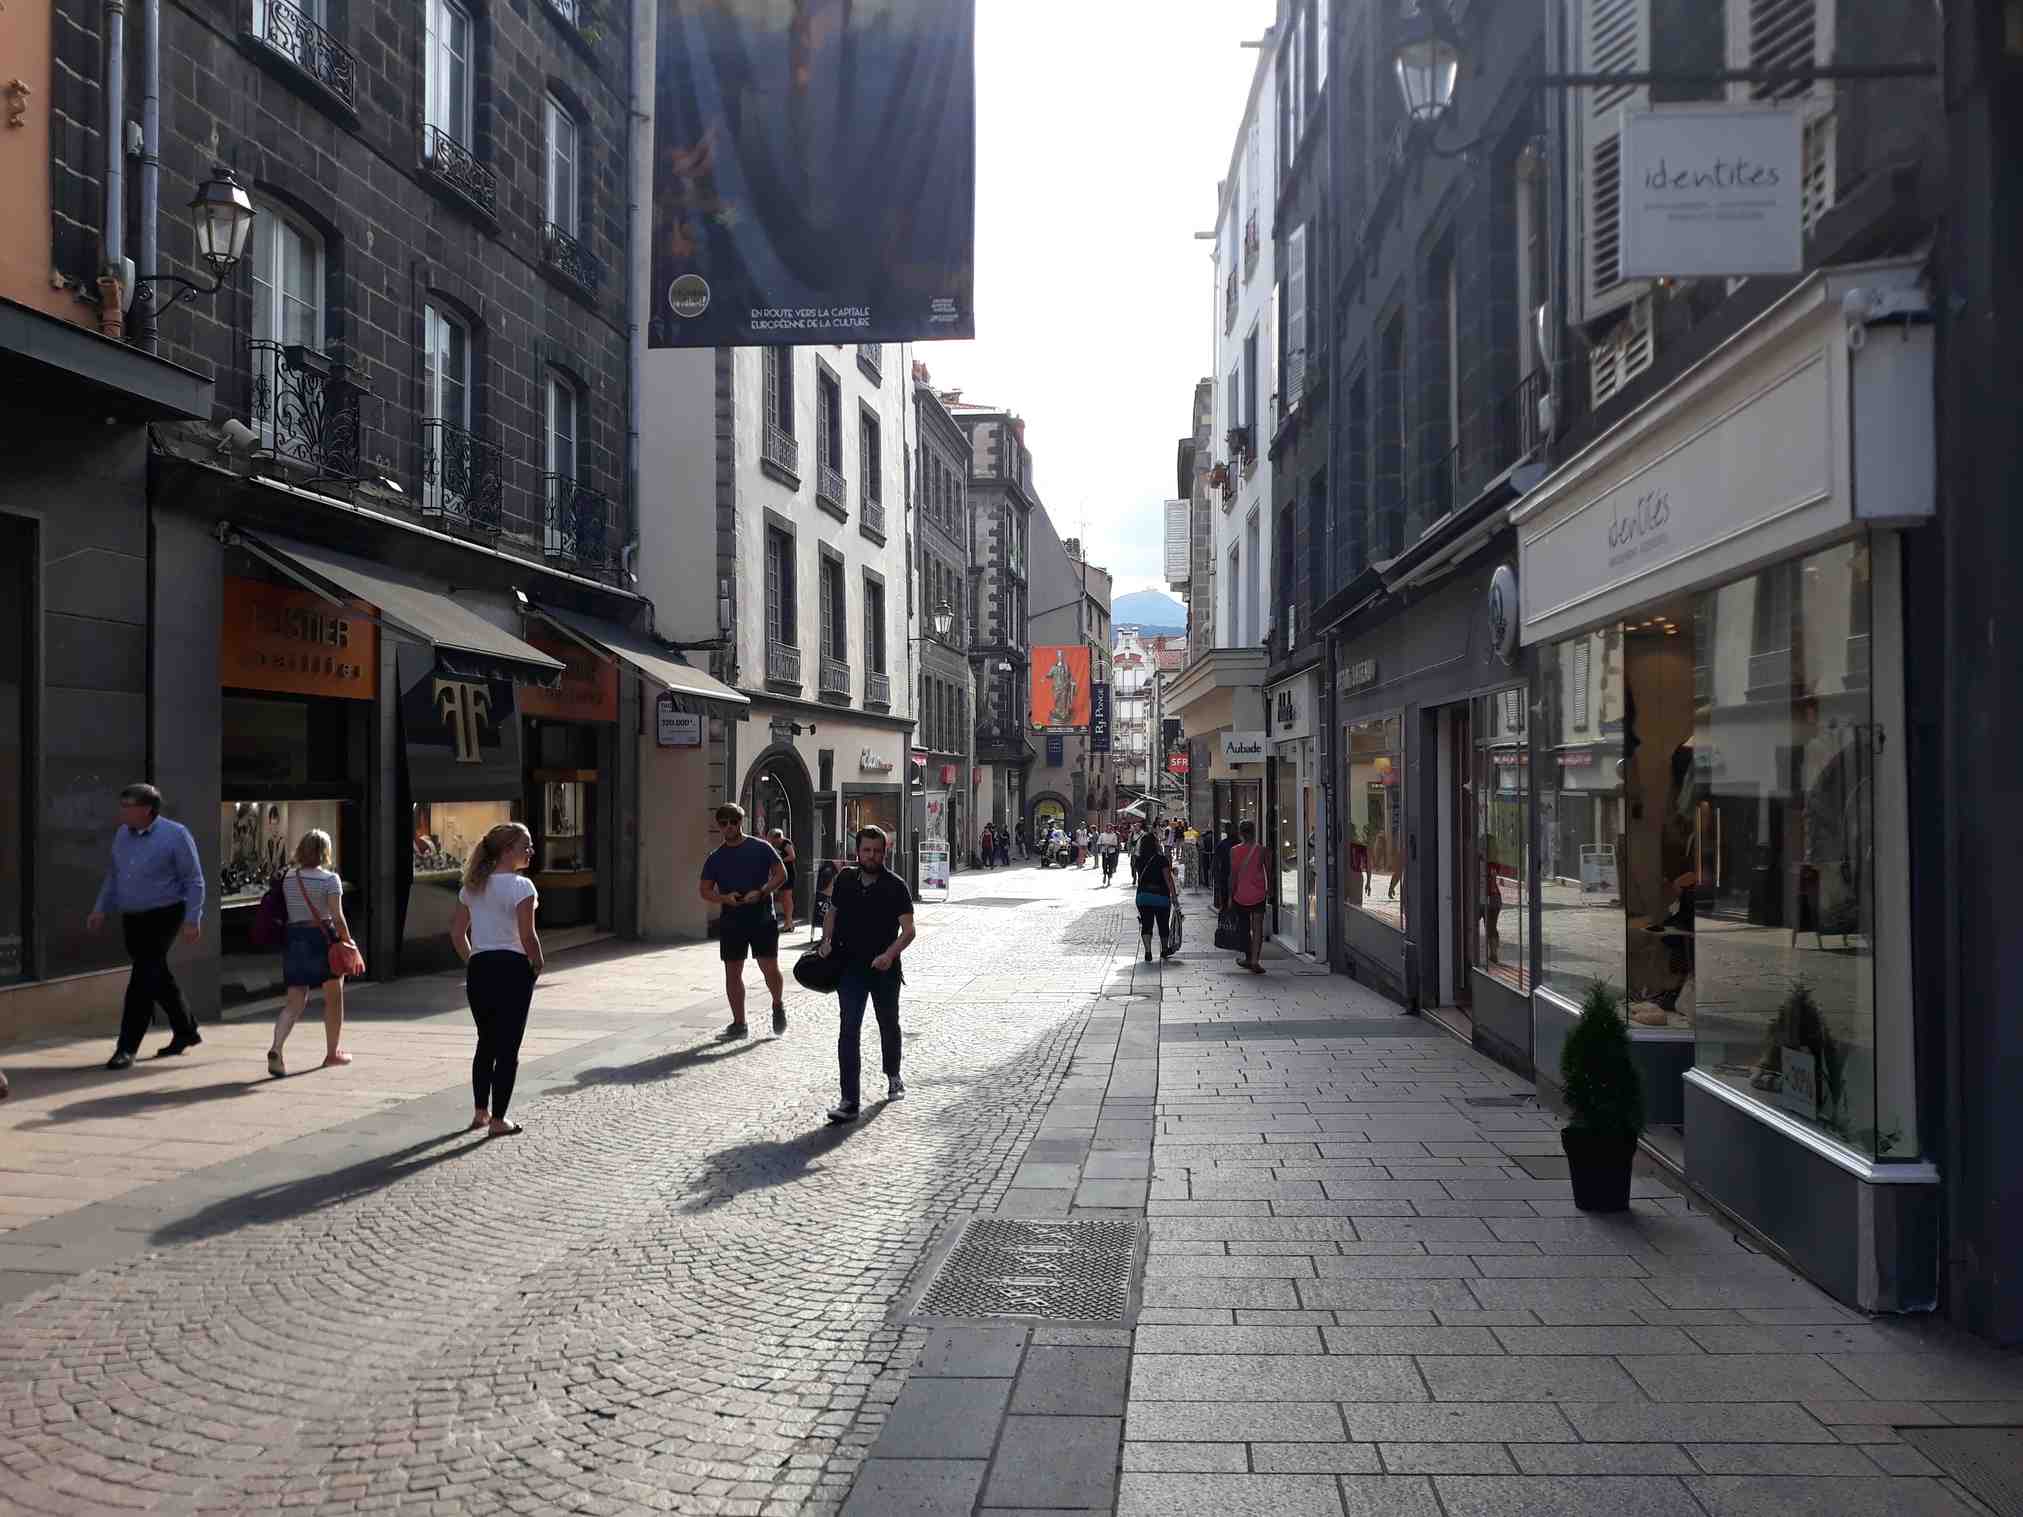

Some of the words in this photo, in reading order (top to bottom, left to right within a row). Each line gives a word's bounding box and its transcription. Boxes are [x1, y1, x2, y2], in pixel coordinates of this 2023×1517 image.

[751, 308, 762, 318] EN
[763, 308, 793, 318] ROUTE
[794, 307, 816, 318] VERS
[818, 307, 830, 317] LA
[831, 306, 871, 317] CAPITALE
[807, 318, 818, 328] DE
[819, 318, 832, 328] LA
[832, 317, 871, 328] CULTURE
[1225, 741, 1262, 754] Aubade
[1169, 757, 1189, 767] SFR
